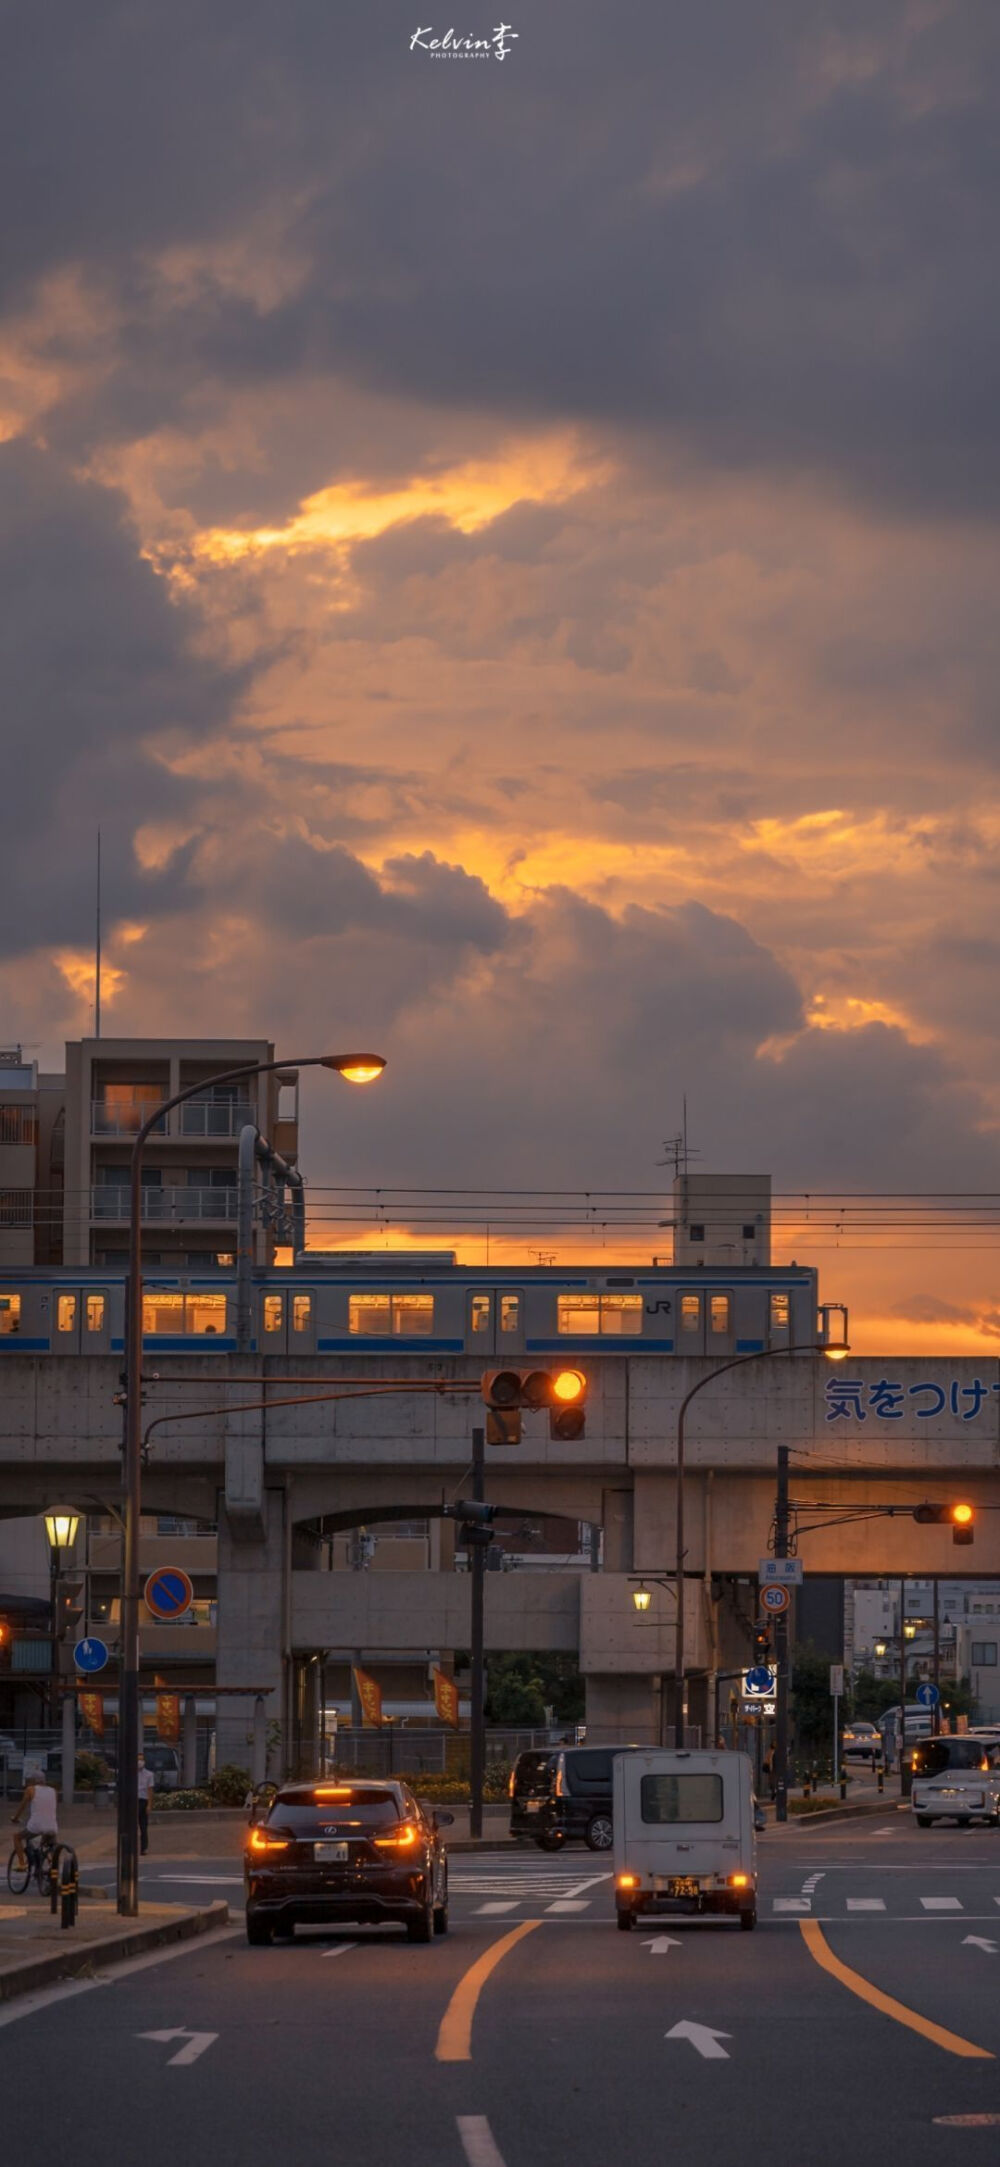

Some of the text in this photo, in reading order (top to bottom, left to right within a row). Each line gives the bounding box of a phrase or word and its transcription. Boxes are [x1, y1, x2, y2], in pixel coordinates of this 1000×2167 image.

[646, 1300, 672, 1314] JR
[825, 1378, 1000, 1421] 気をつけ
[767, 1591, 784, 1605] 50
